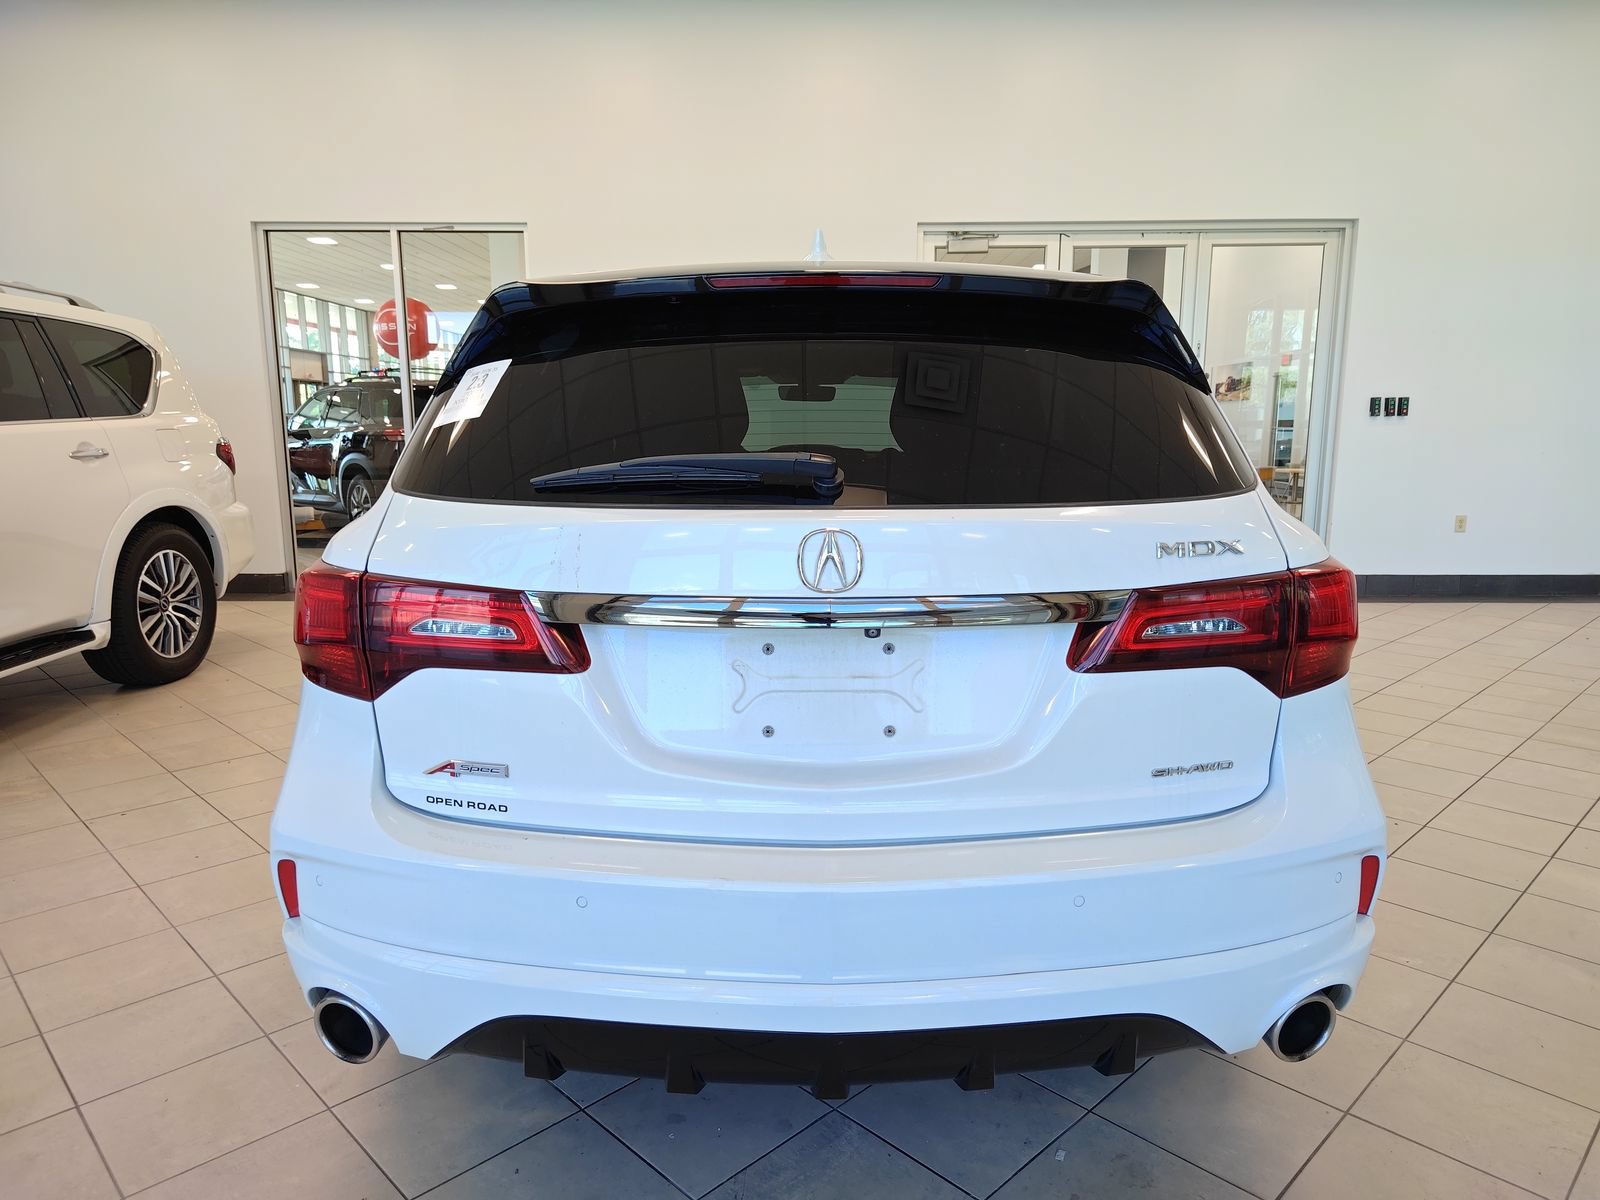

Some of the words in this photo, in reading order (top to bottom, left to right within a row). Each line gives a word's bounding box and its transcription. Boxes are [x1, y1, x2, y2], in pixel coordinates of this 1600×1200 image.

[375, 322, 417, 331] NISSN
[1155, 539, 1245, 559] MDX
[1151, 760, 1234, 778] SH-AWD
[426, 795, 463, 808] OPEN
[467, 801, 508, 813] ROAD
